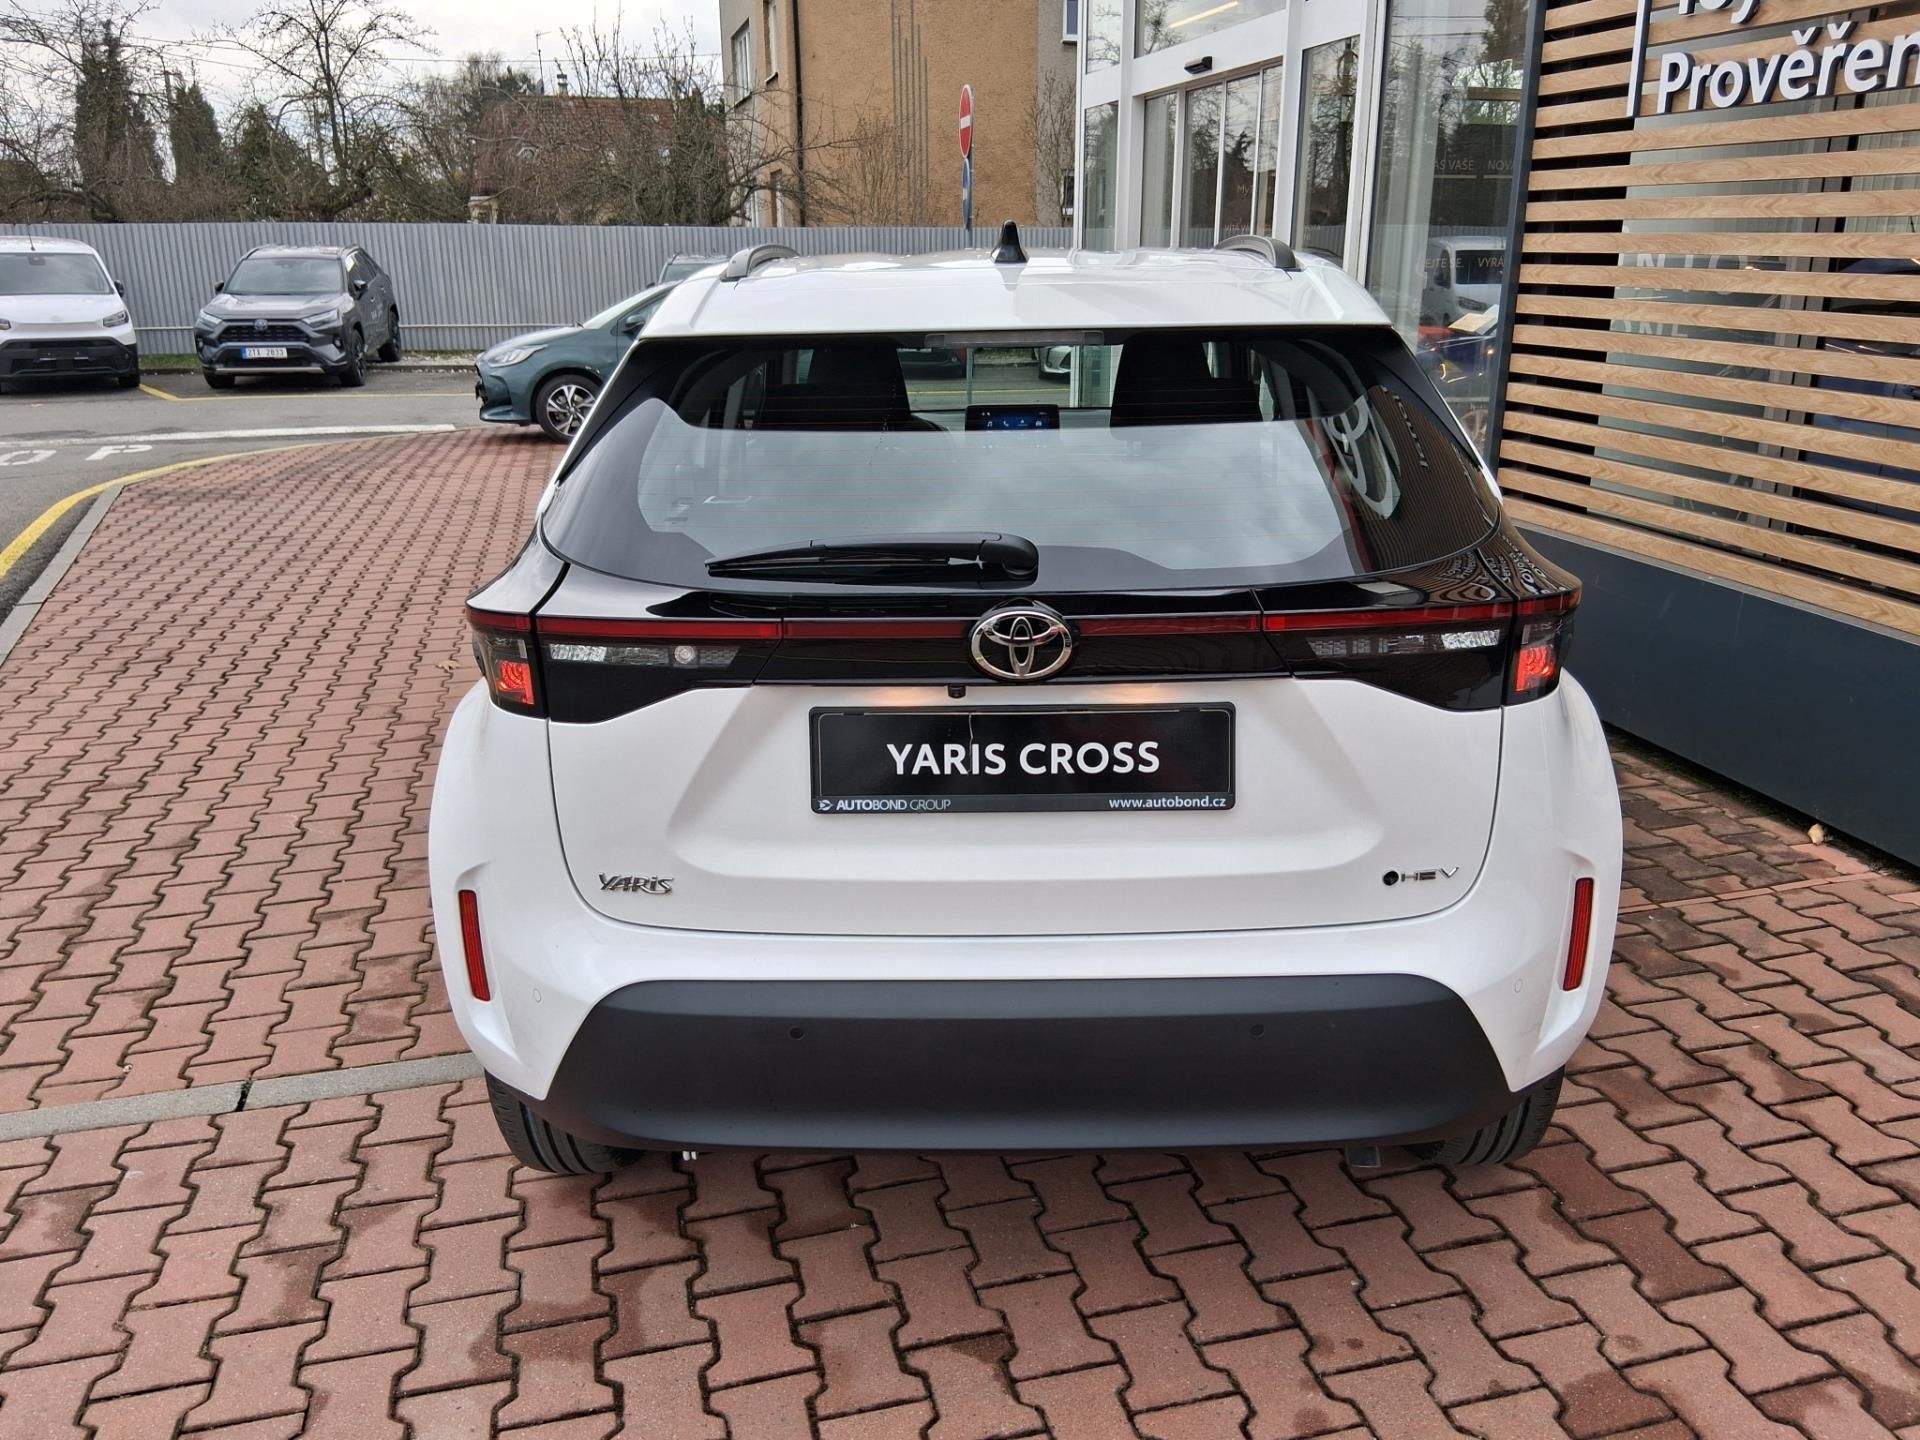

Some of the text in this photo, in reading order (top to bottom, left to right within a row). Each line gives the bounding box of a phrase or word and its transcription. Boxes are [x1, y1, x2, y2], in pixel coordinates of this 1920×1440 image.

[887, 741, 1160, 775] YARIS CROSS
[836, 799, 951, 811] AUTOBOND GROUP
[1108, 795, 1227, 809] www.autobond.cz
[1401, 866, 1459, 882] HEV
